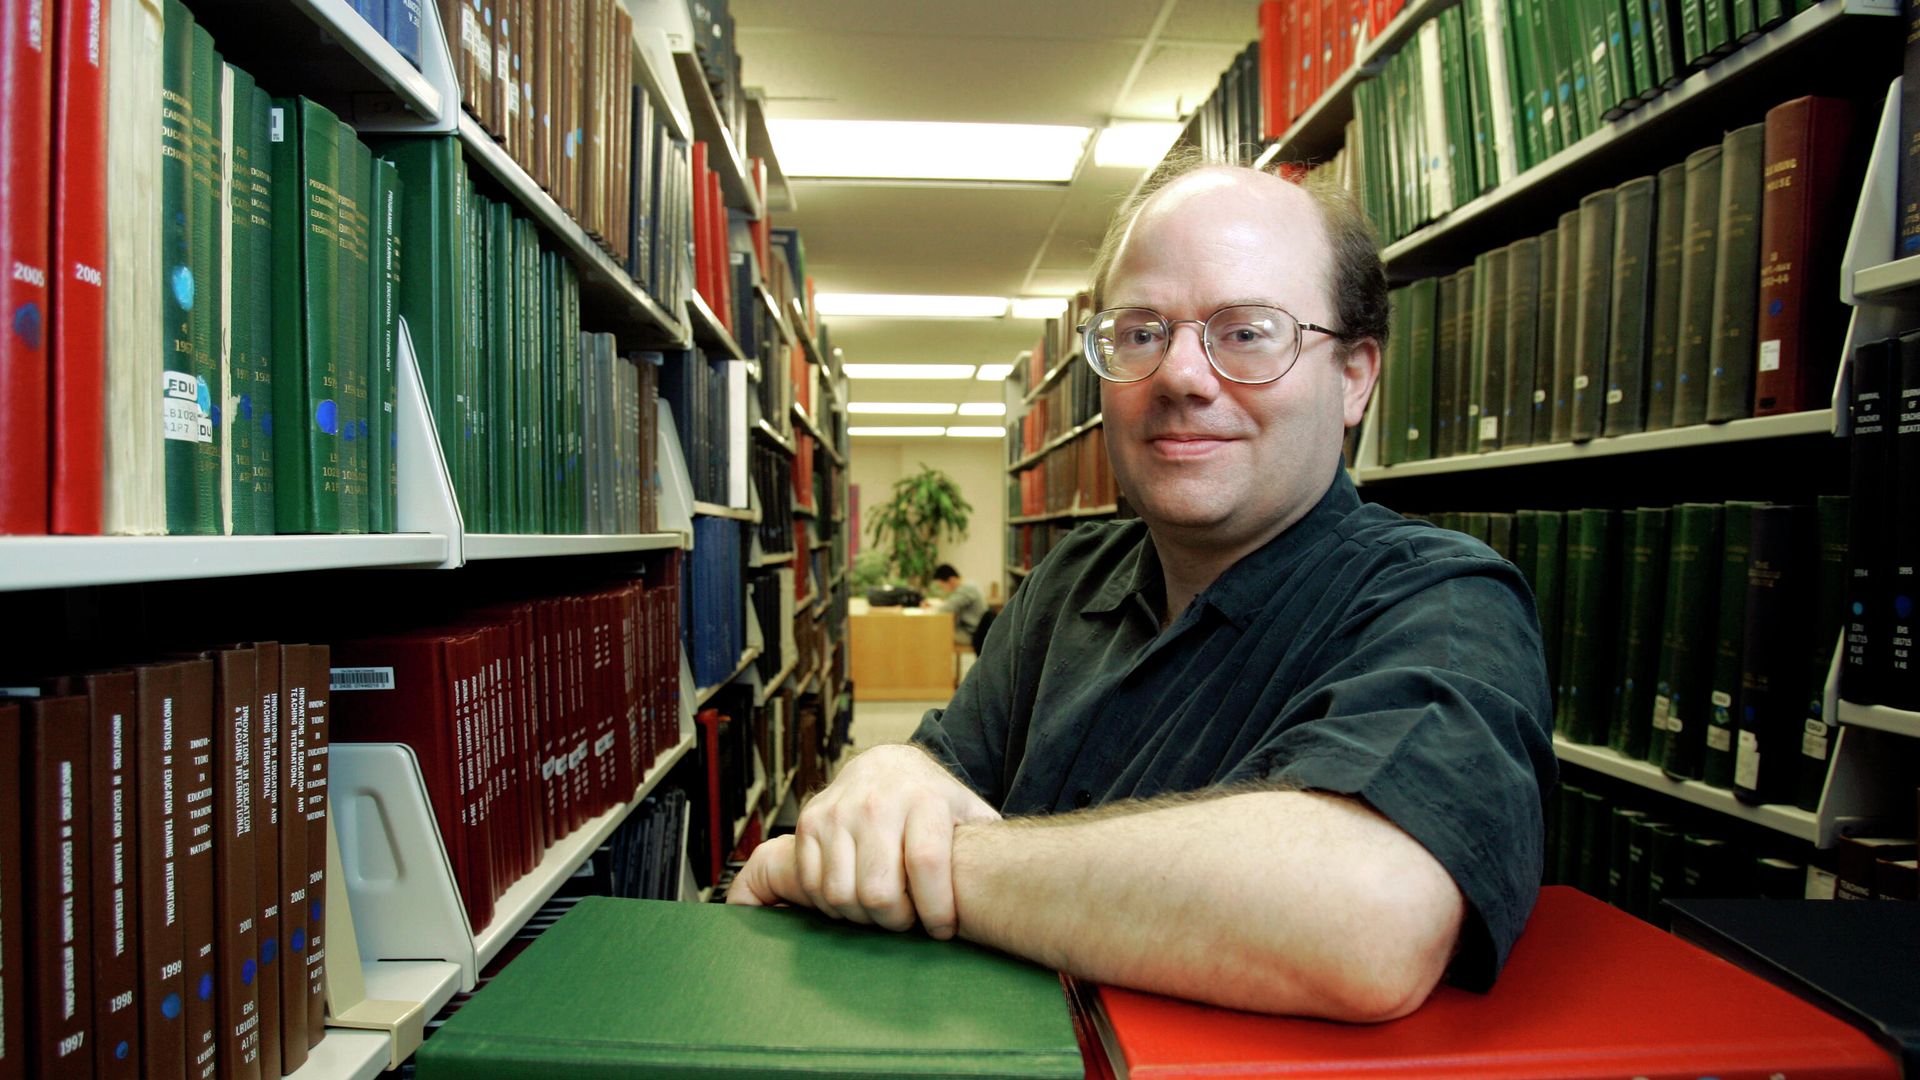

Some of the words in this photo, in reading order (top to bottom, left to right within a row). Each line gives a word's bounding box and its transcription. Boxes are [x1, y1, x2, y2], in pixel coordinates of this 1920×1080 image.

[14, 261, 45, 288] 2005
[75, 262, 102, 288] 2006
[168, 378, 195, 396] EDU
[197, 424, 212, 438] DU
[235, 706, 242, 714] &
[263, 694, 271, 733] TEACHING
[290, 688, 298, 725] TEACHING
[163, 698, 173, 751] INNOVATIONS
[235, 717, 243, 761] TEACHING
[242, 705, 250, 766] INNOVATIONS
[113, 715, 123, 771] INNOVATIONS
[271, 748, 278, 757] IN
[291, 729, 299, 788] INTERNATIONAL
[298, 740, 305, 748] IN
[163, 756, 172, 765] IN
[243, 769, 250, 780] IN
[113, 775, 122, 786] IN
[164, 769, 173, 815] EDUCATION
[113, 789, 123, 838] EDUCATION
[236, 765, 245, 838] INTERNATIONAL
[243, 783, 251, 833] EDUCATION
[164, 818, 174, 858] TRAINING
[63, 841, 73, 894] EDUCATION
[114, 842, 123, 885] TRAINING
[309, 872, 323, 885] 2004
[165, 862, 175, 927] INTERNATIONAL
[290, 888, 305, 904] 2003
[63, 897, 74, 942] TRAINING
[115, 888, 125, 957] INTERNATIONAL
[240, 918, 253, 935] 2001
[264, 905, 279, 919] 2002
[200, 943, 213, 958] 2000
[64, 946, 75, 1021] INTERNATIONAL
[161, 960, 183, 980] 1999
[111, 990, 133, 1014] 1998
[60, 1031, 86, 1059] 1997
